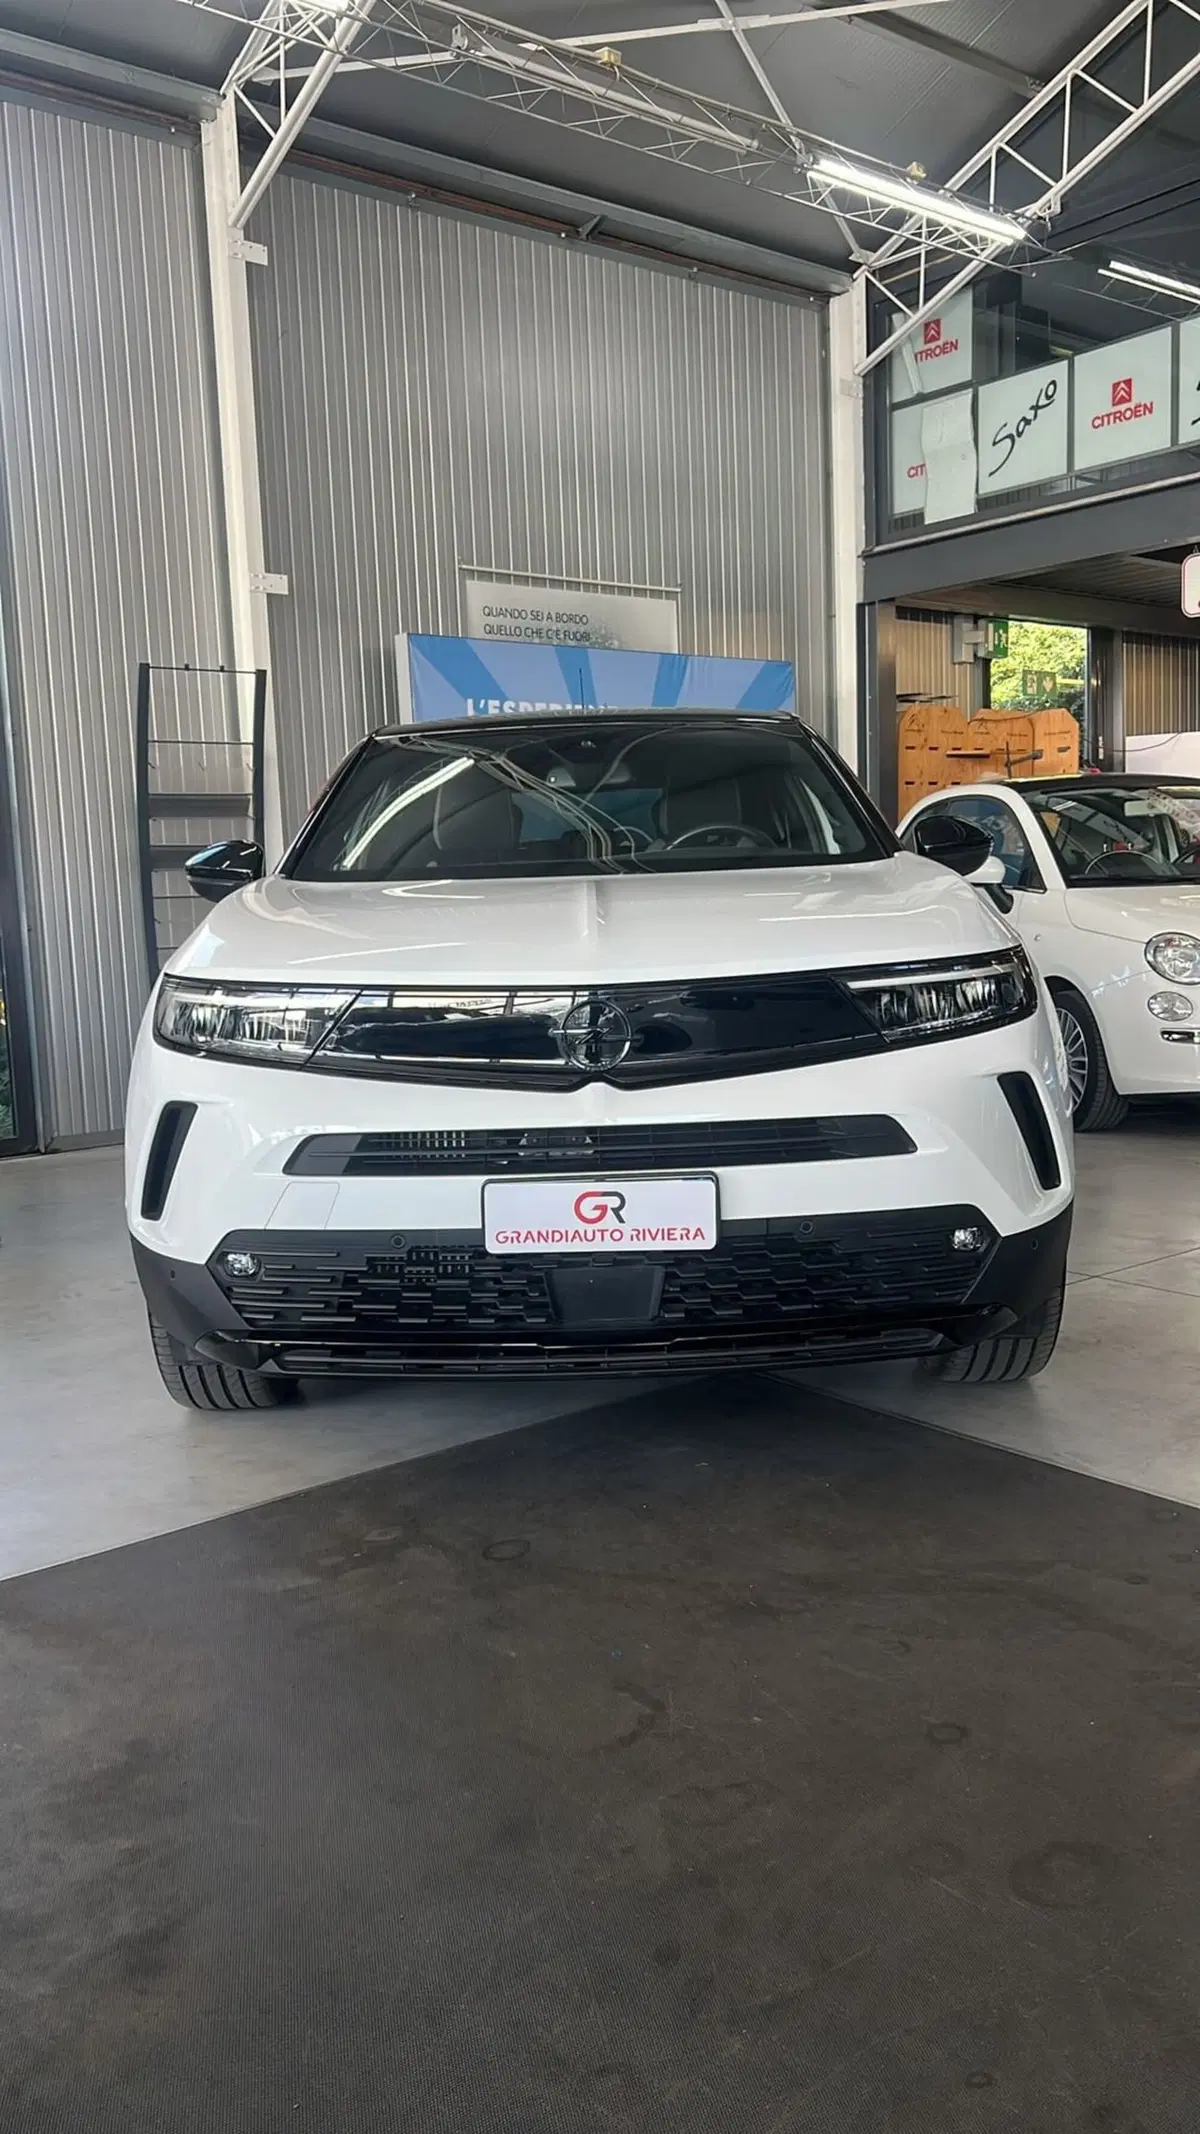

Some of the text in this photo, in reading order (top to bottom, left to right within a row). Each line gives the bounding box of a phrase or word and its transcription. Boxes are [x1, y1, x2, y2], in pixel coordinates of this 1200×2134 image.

[914, 338, 959, 364] ITROËN
[989, 379, 1058, 477] Saxo
[1091, 401, 1154, 430] CITROËN
[482, 605, 589, 626] QUANDO SEI A BORDO
[484, 623, 522, 638] QUELLO
[524, 627, 544, 640] CHE
[563, 630, 591, 642] FUORI
[574, 1191, 626, 1224] GR
[495, 1227, 706, 1244] GRANDIAUTO RIVIERA
